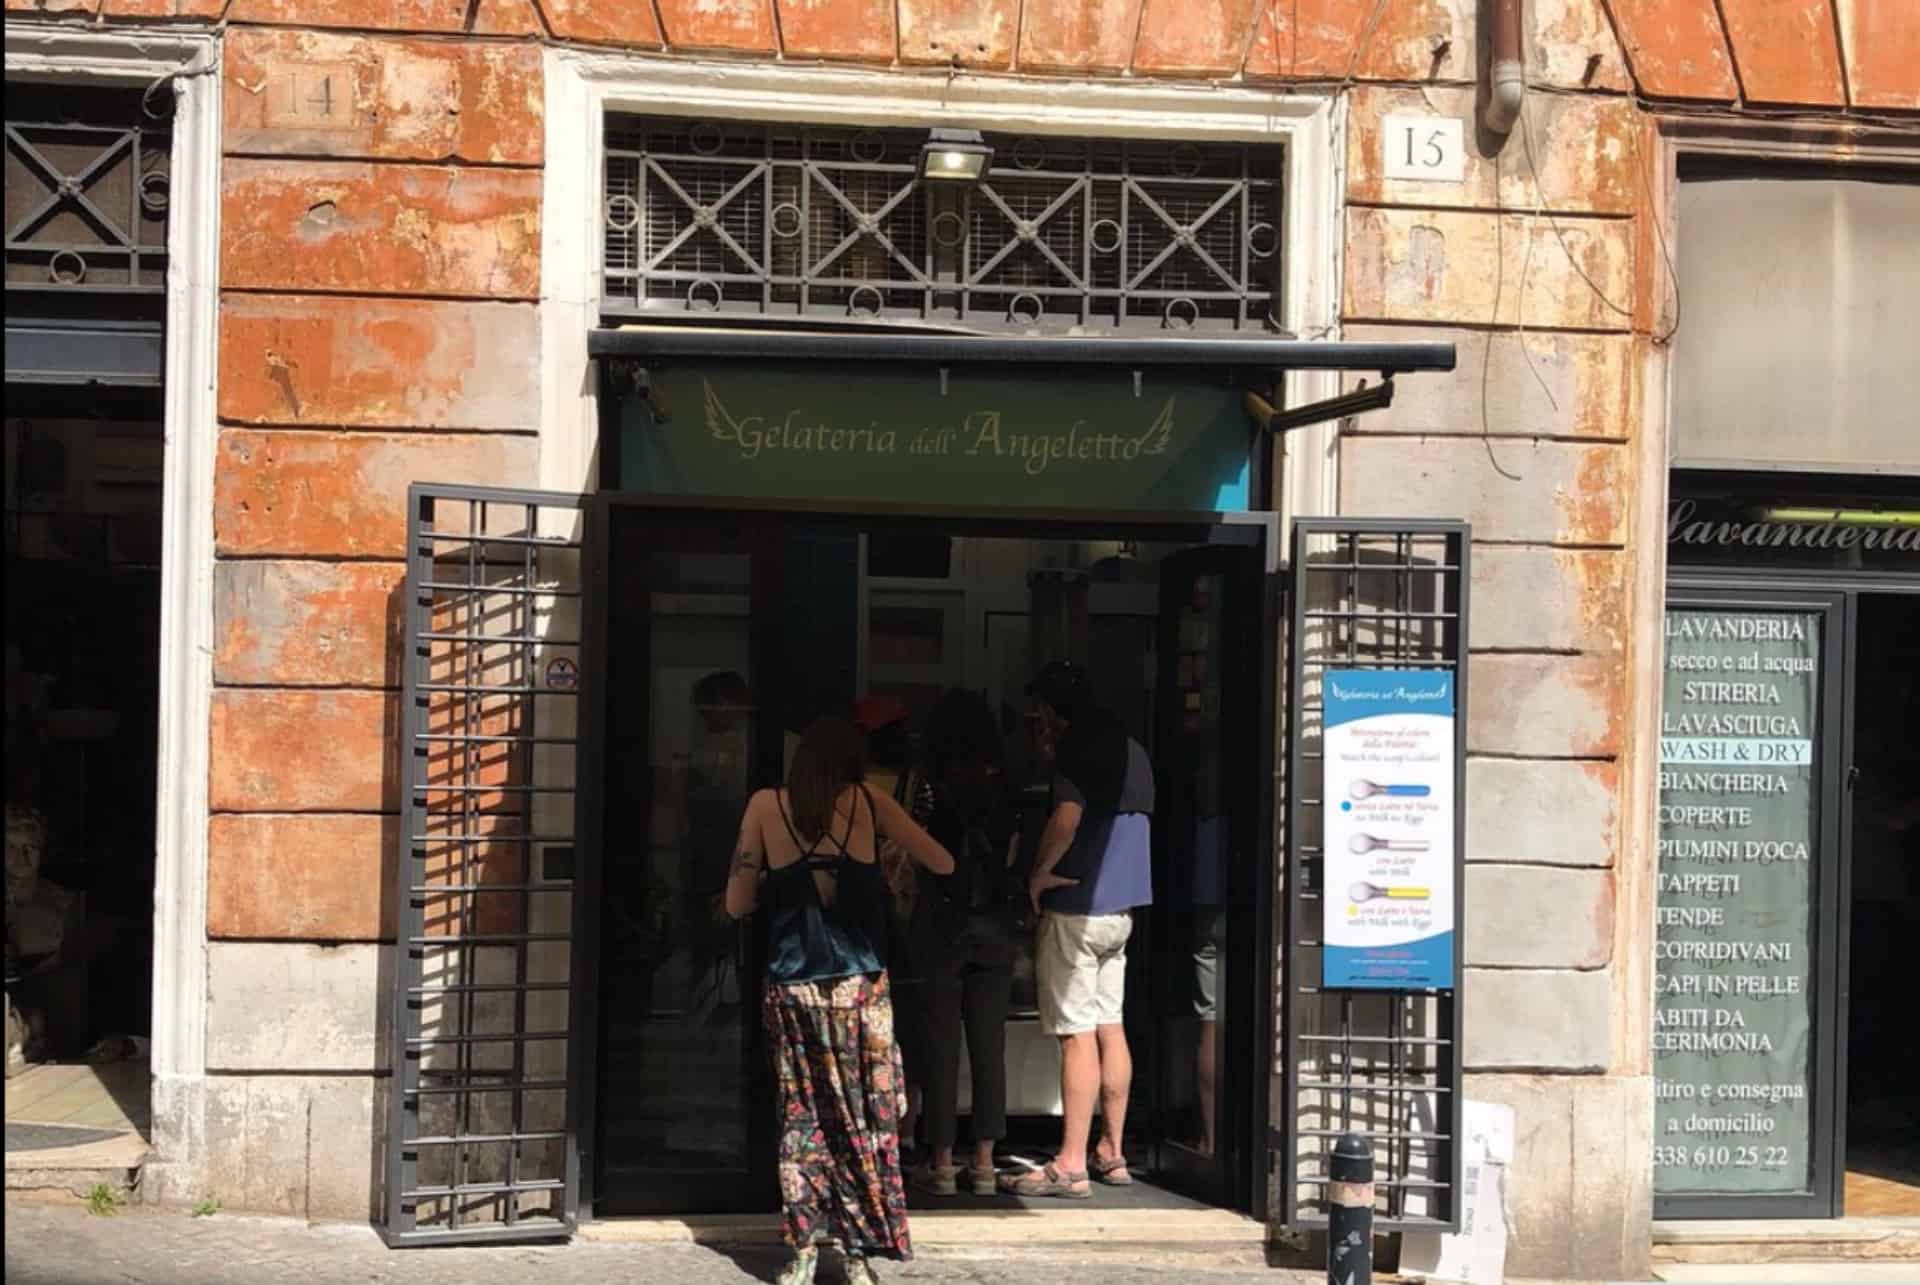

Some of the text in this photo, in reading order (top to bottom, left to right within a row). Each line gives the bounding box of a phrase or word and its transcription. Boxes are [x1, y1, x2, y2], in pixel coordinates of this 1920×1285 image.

[1405, 127, 1448, 168] 15
[735, 409, 897, 460] Gelateria
[1666, 617, 1805, 640] LAVANDERIA
[1670, 651, 1815, 677] secco e ad acqua
[1684, 681, 1781, 704] STIRERIA
[1664, 712, 1801, 737] LAVASCIUGA
[1661, 741, 1805, 761] WASH & DRY
[1659, 771, 1789, 793] BIANCHERIA
[1658, 805, 1753, 826] COPERTE
[1656, 839, 1809, 860] PIUMINI D'OCA
[1657, 873, 1741, 892] TAPPETI
[1656, 907, 1725, 926] TENDE
[1655, 940, 1793, 961] COPRIDIVANI
[1654, 974, 1801, 994] CAPI IN PELLE
[1653, 1009, 1745, 1027] ABITI DA
[1652, 1032, 1773, 1051] CERIMONIA
[1655, 1079, 1804, 1103] itiro e consegna
[1668, 1112, 1775, 1132] a domicilio
[1693, 1146, 1730, 1165] 610
[1735, 1146, 1758, 1165] 25
[1764, 1146, 1789, 1165] 22
